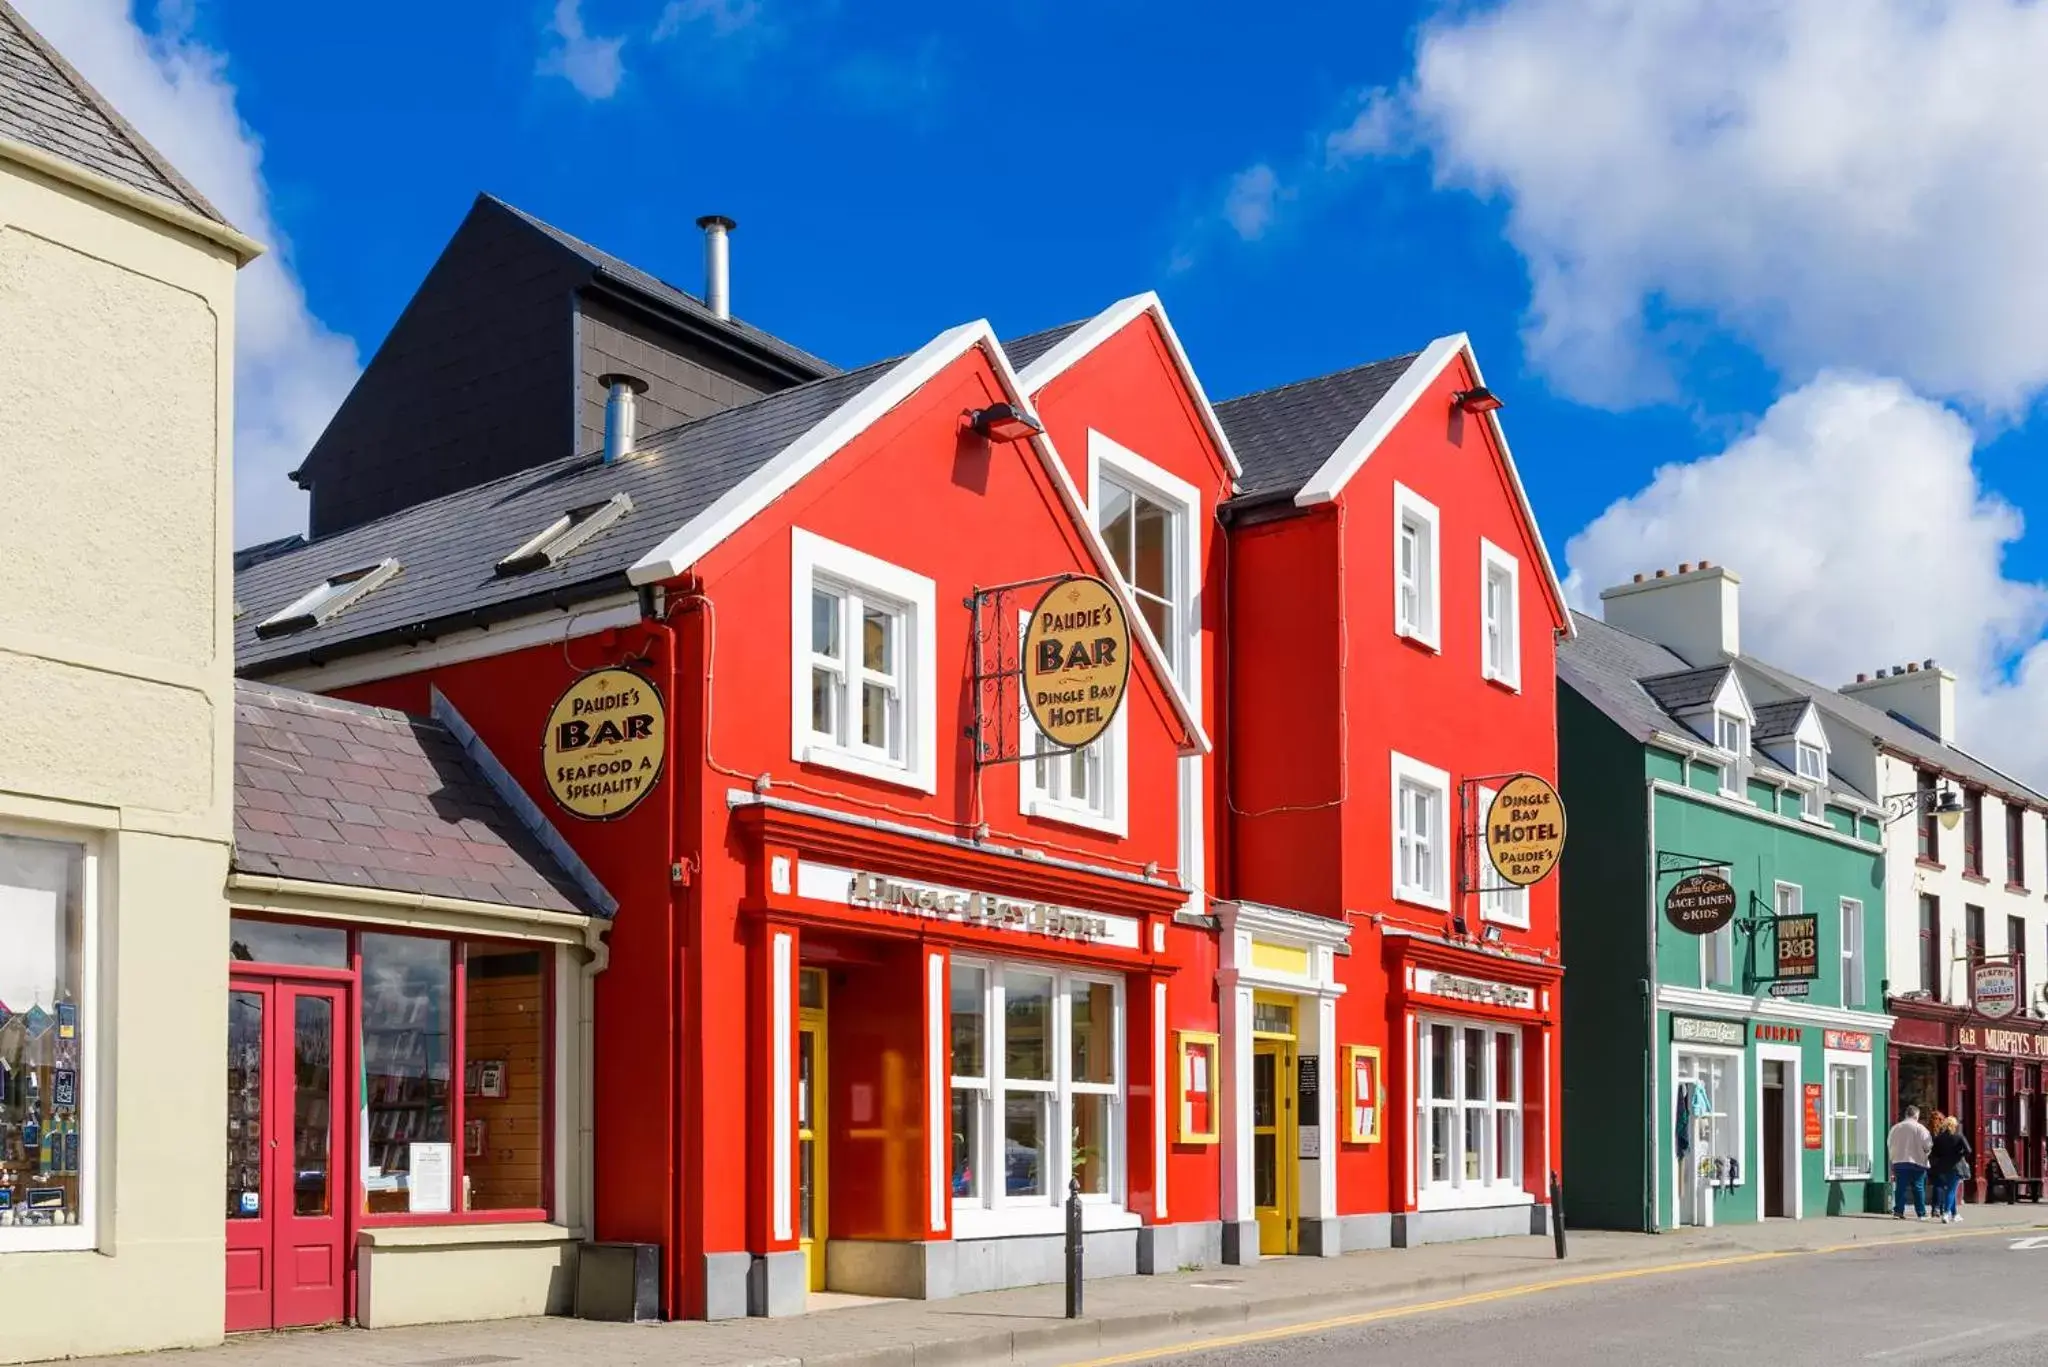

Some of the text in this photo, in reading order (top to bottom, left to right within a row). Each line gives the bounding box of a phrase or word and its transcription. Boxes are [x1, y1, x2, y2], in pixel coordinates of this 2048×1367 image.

[1042, 604, 1113, 633] PAUDIE'S
[1036, 637, 1118, 676] BAR
[573, 688, 640, 716] PAUDIE'S
[1036, 684, 1117, 707] DINGLE BAY
[1048, 706, 1103, 728] HOTEL
[556, 713, 655, 753] BAR
[557, 756, 652, 783] SEAFOOD A
[566, 776, 643, 800] SPECIALITY
[1502, 793, 1551, 808] DINGLE
[1511, 809, 1539, 822] BAY
[1493, 823, 1559, 844] HOTEL
[1500, 848, 1553, 863] PAUDIE'S
[1511, 865, 1540, 876] BAR
[1667, 894, 1732, 909] LACE LINEN
[1778, 938, 1815, 960] B&B
[1985, 1028, 2030, 1054] MURPHYS
